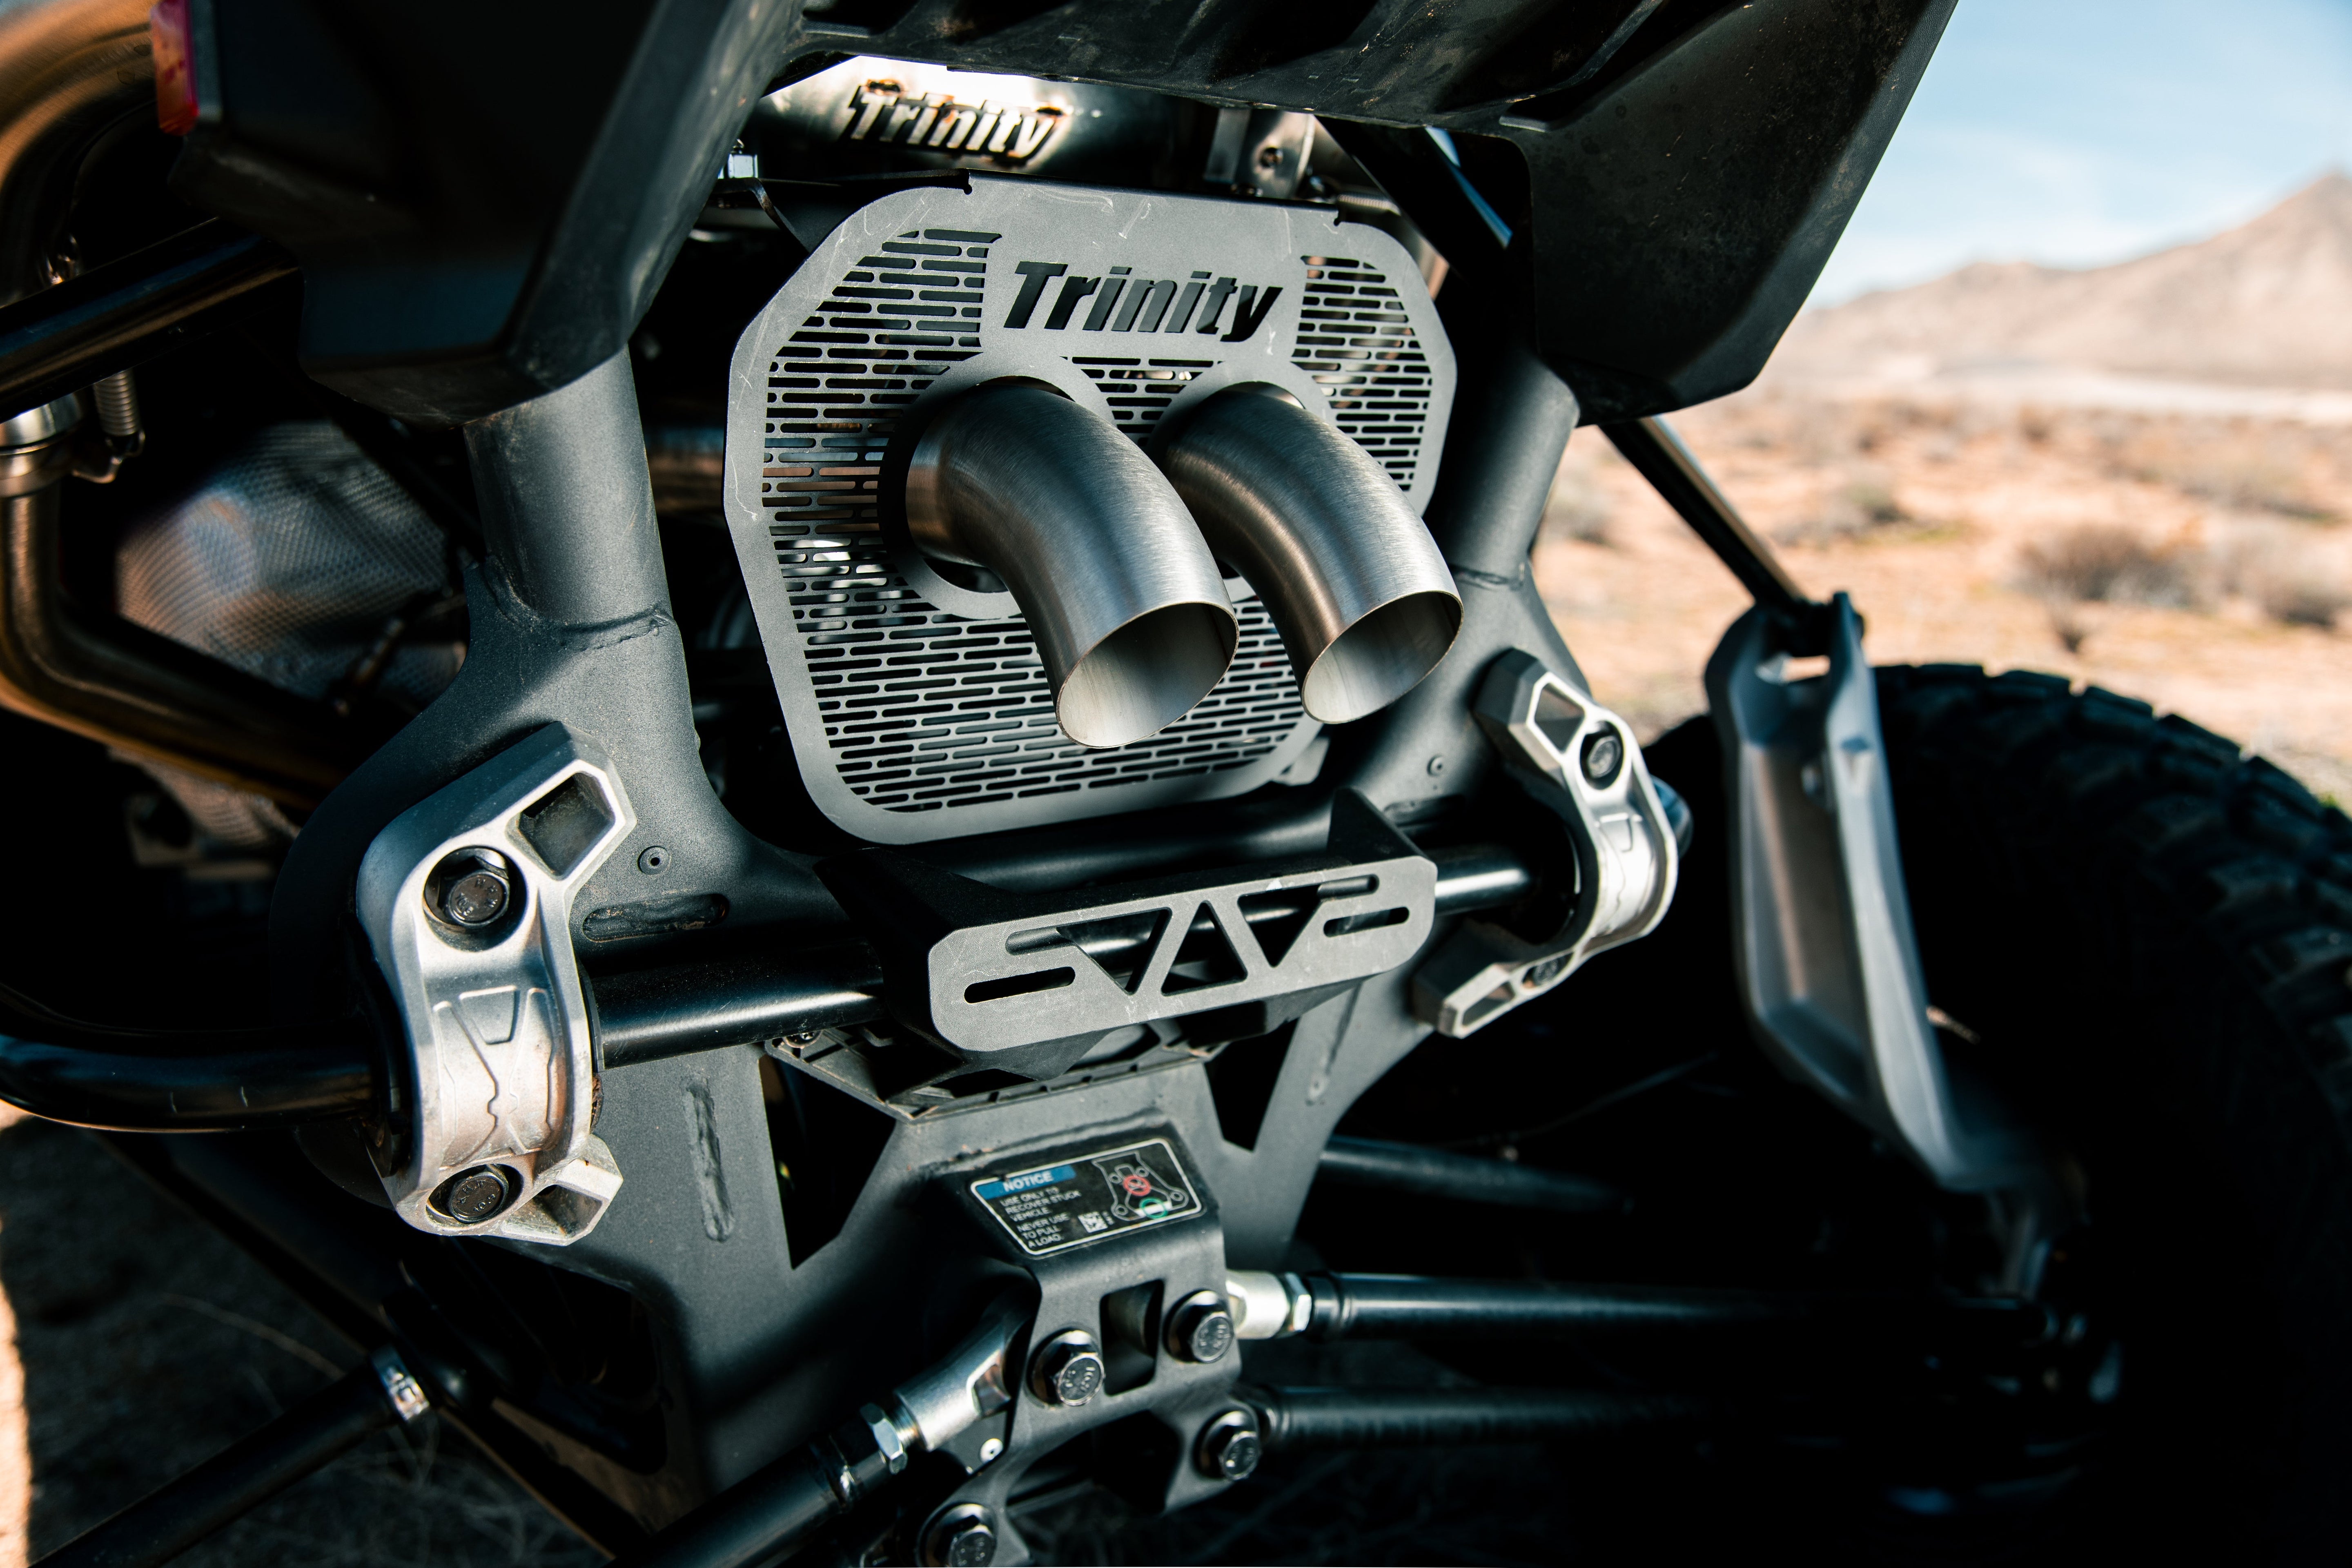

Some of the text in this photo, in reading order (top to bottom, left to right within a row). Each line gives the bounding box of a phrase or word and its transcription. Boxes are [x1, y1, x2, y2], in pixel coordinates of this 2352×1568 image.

[847, 86, 1059, 163] Trinity
[1003, 261, 1283, 342] Trinity
[1002, 1171, 1054, 1192] NOTICE
[1000, 1186, 1060, 1207] USE ONLY TO
[1005, 1189, 1082, 1214] RECOVER STUCK
[1017, 1212, 1071, 1232] NEVER USE
[1022, 1225, 1062, 1240] TO PULL
[1028, 1239, 1036, 1248] A
